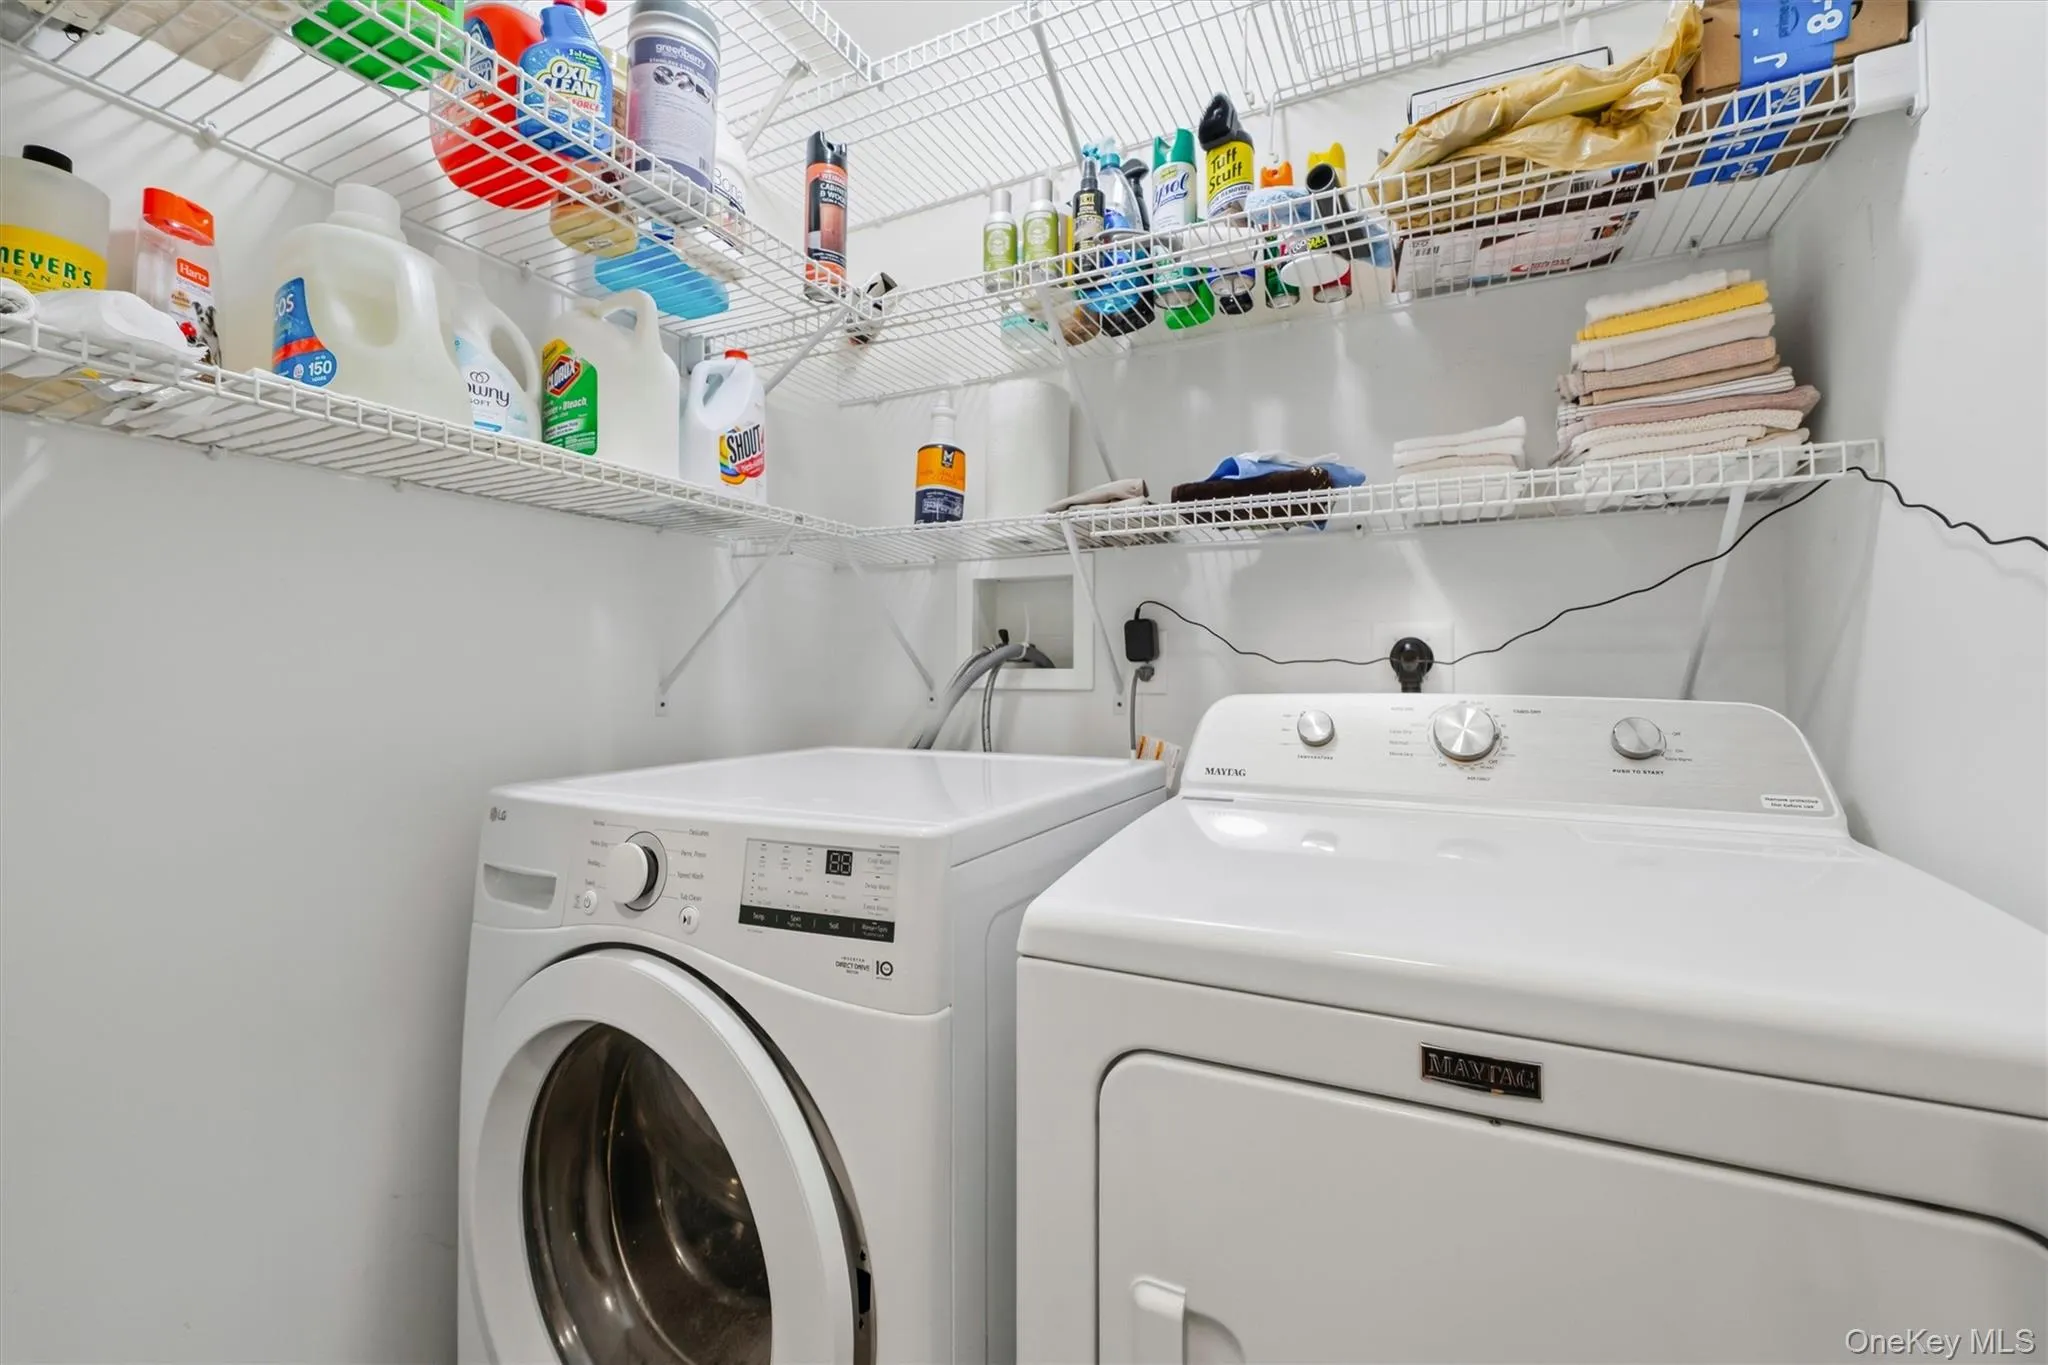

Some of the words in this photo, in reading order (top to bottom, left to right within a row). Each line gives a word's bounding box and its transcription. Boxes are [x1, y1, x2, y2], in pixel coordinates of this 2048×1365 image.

[655, 44, 707, 70] greenberry
[551, 61, 587, 82] OXI
[538, 73, 597, 98] CLEAN
[1210, 147, 1238, 174] Tuff
[308, 359, 333, 377] 150
[547, 358, 578, 391] CLOROX
[727, 424, 762, 464] SHOUT
[1204, 767, 1247, 777] MAYTAG
[1428, 1053, 1537, 1091] MAYTAG
